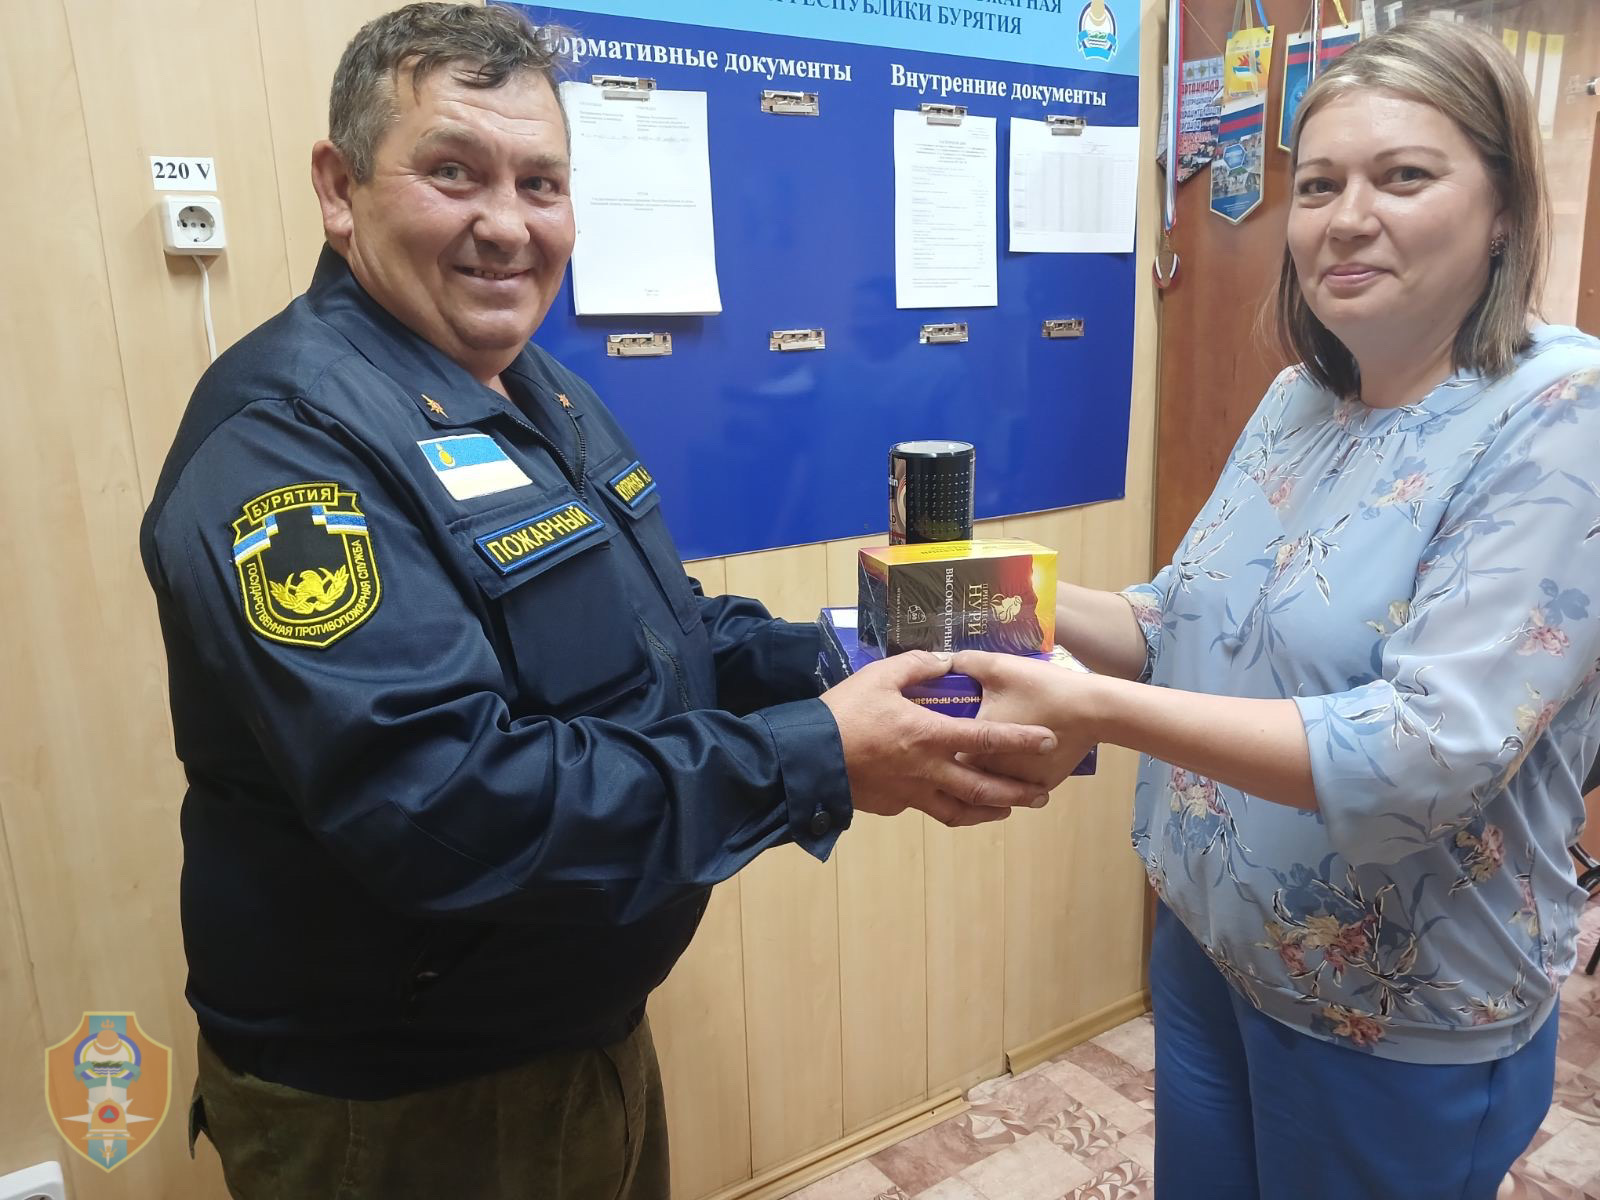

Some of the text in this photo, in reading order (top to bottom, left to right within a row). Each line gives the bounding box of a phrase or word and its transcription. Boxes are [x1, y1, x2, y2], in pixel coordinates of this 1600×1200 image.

[789, 0, 1022, 35] ПУБЛИКИ БУРЯТИЯ
[724, 51, 852, 82] документы
[890, 63, 1107, 107] Внутренние документы
[153, 161, 210, 180] 220 V
[252, 487, 332, 518] БУРЯТИЯ
[486, 505, 593, 564] ПОЖАРНЫЙ
[246, 539, 371, 637] ГОСУДАРСТВЕННАЯ ПРОТИВОПОЖАРНАЯ СЛУЖБА
[968, 584, 982, 636] НУРИ
